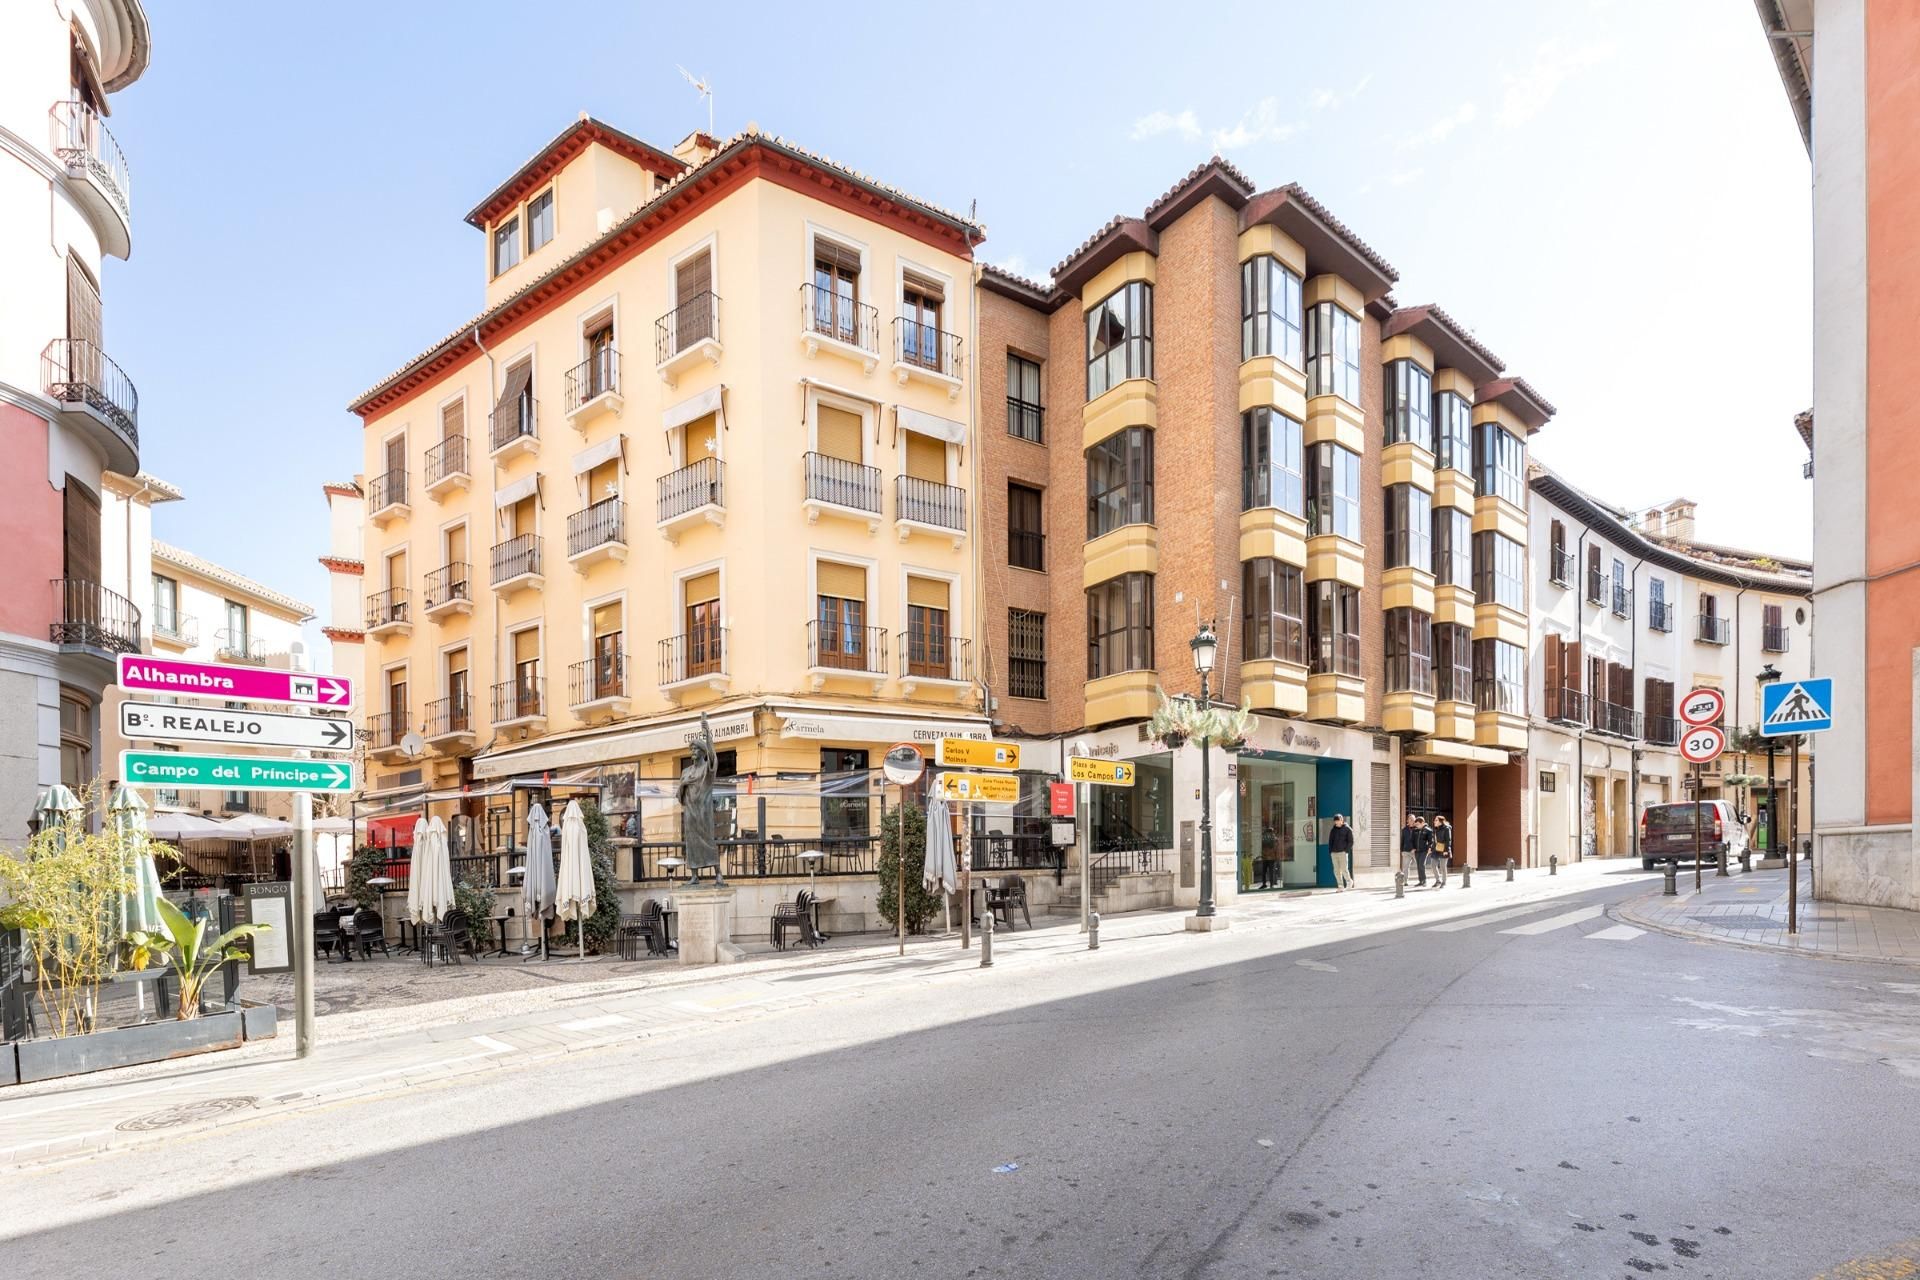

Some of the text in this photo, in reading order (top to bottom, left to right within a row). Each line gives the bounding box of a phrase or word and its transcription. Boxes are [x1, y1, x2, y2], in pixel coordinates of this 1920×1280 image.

[126, 665, 234, 689] Alhambra
[163, 715, 262, 735] REALEJO
[714, 723, 749, 738] ALHAMBRA
[945, 746, 964, 754] Carlos
[1690, 738, 1714, 751] 30
[945, 755, 967, 763] Molinos
[1072, 760, 1088, 769] Plaza
[132, 761, 320, 784] Campo del Príncipe
[1072, 769, 1085, 778] Los
[1087, 770, 1114, 781] Campos
[250, 885, 288, 895] BONGO
